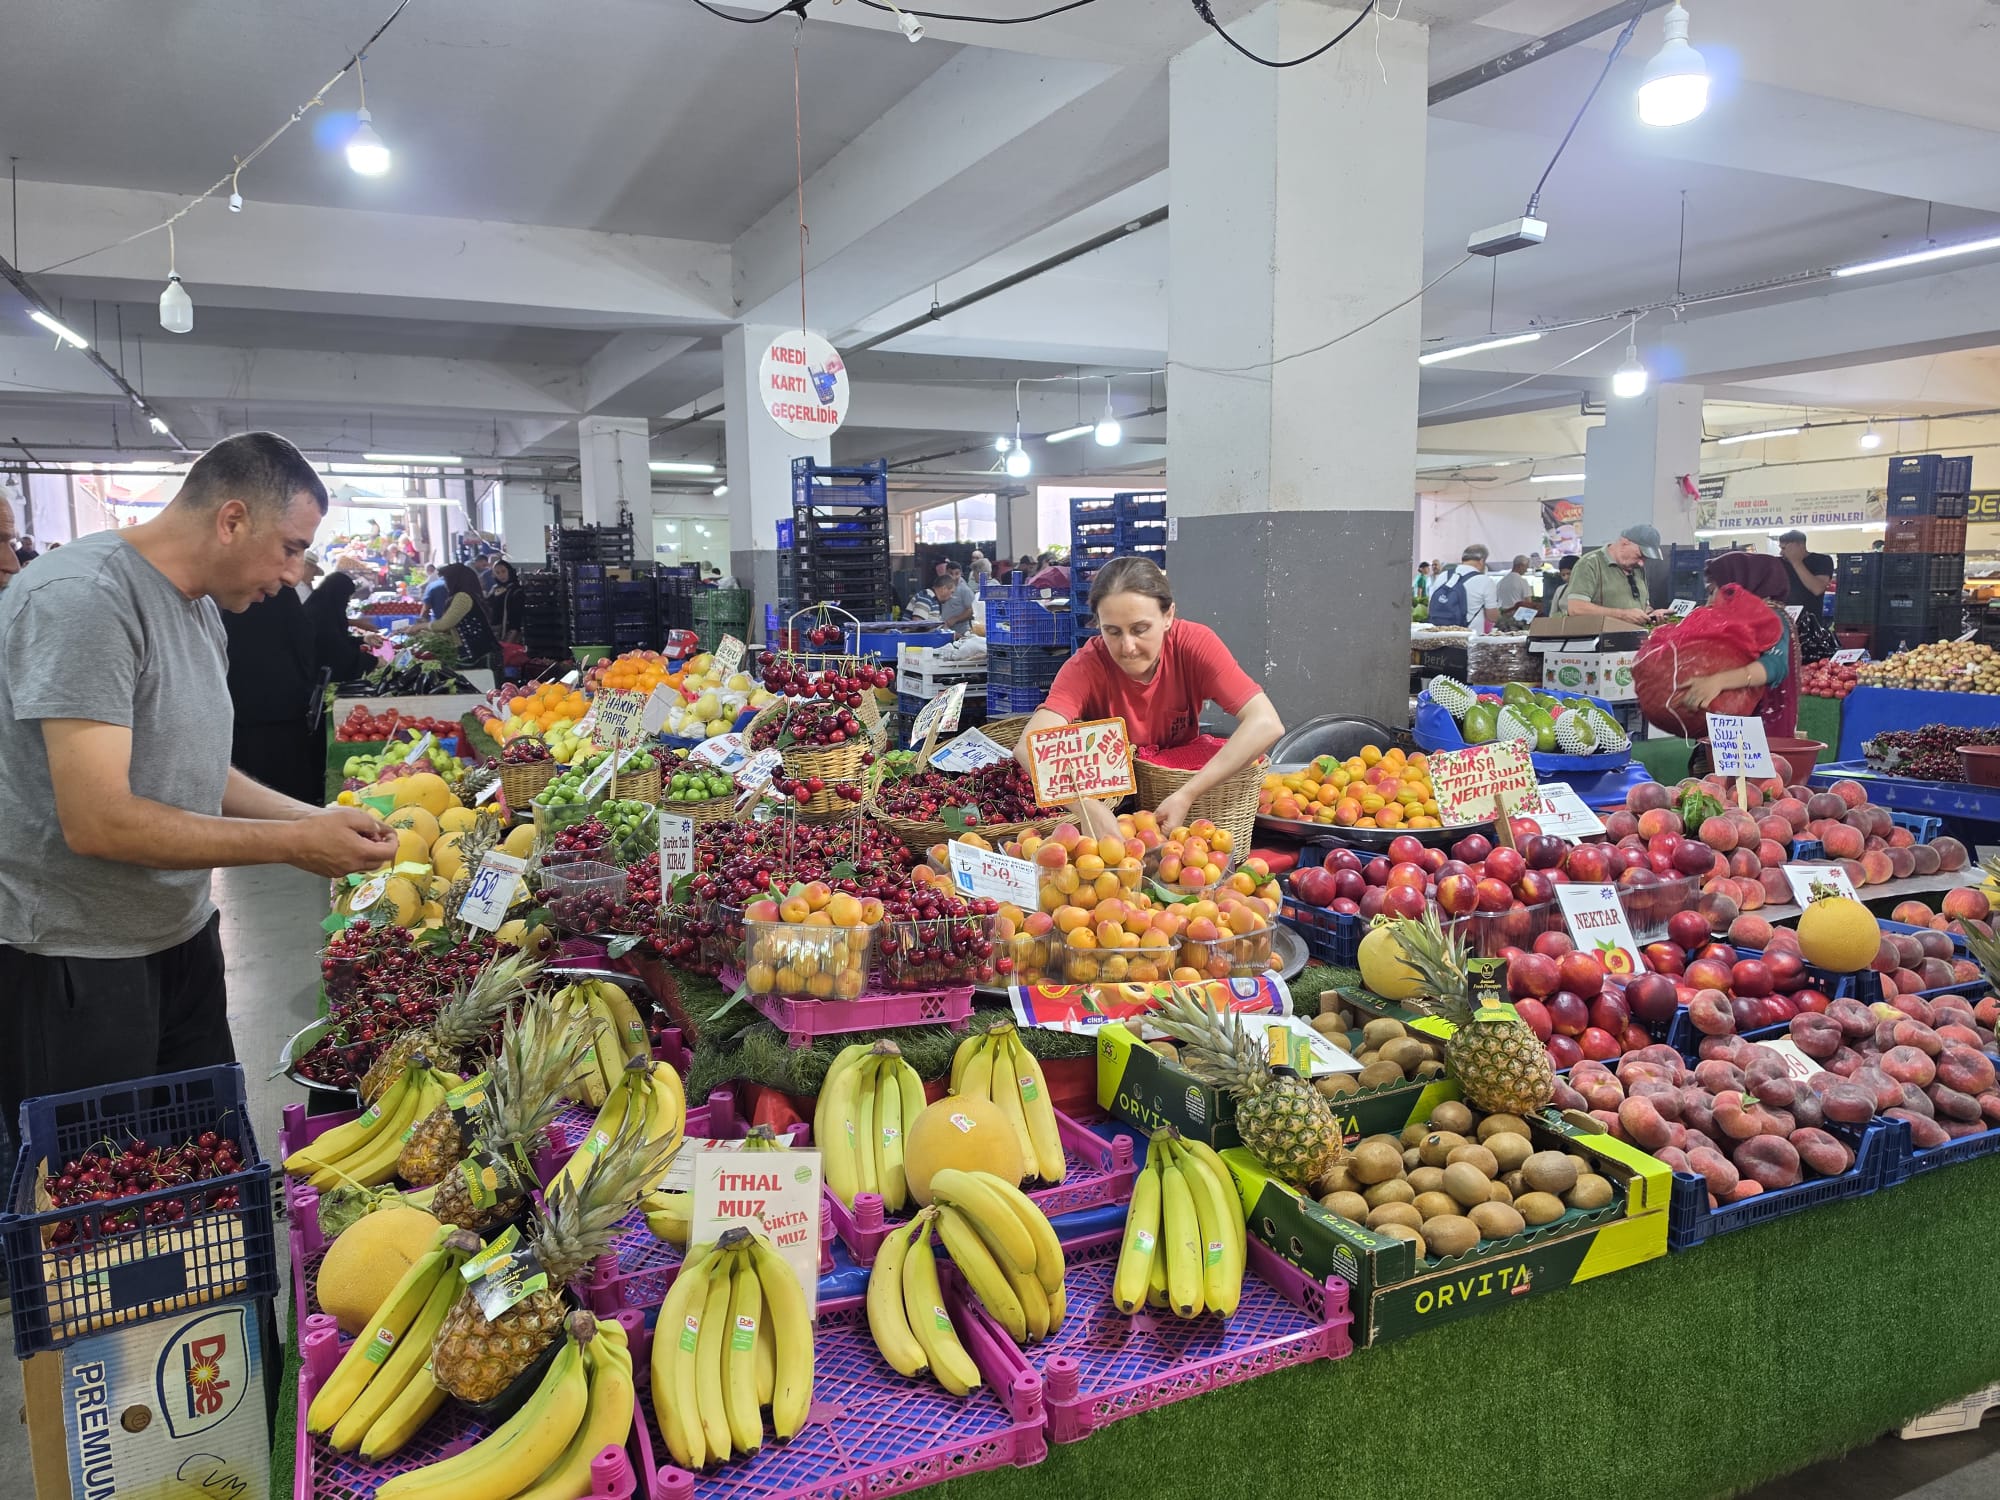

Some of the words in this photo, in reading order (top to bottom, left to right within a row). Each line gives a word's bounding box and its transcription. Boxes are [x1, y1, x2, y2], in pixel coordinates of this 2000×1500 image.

[771, 346, 806, 365] KREDİ
[771, 374, 806, 393] KARTI
[771, 402, 838, 424] GEÇERLİDİR
[1718, 517, 1742, 527] TİRE
[1745, 516, 1784, 526] YAYLA
[1789, 512, 1808, 525] SÜT
[601, 710, 628, 726] PAPAZ
[1710, 717, 1743, 727] TATLI
[1050, 753, 1100, 773] TATLI
[1449, 756, 1495, 777] BURSA
[981, 861, 1010, 880] 150
[469, 867, 500, 901] 150
[1573, 908, 1621, 929] NEKTAR
[719, 1170, 783, 1191] İTHAL
[717, 1200, 766, 1217] MUZ
[763, 1211, 808, 1233] ÇİKİTA
[777, 1229, 807, 1247] MUZ
[1415, 1263, 1530, 1314] ORVITA
[191, 1333, 231, 1415] Dole
